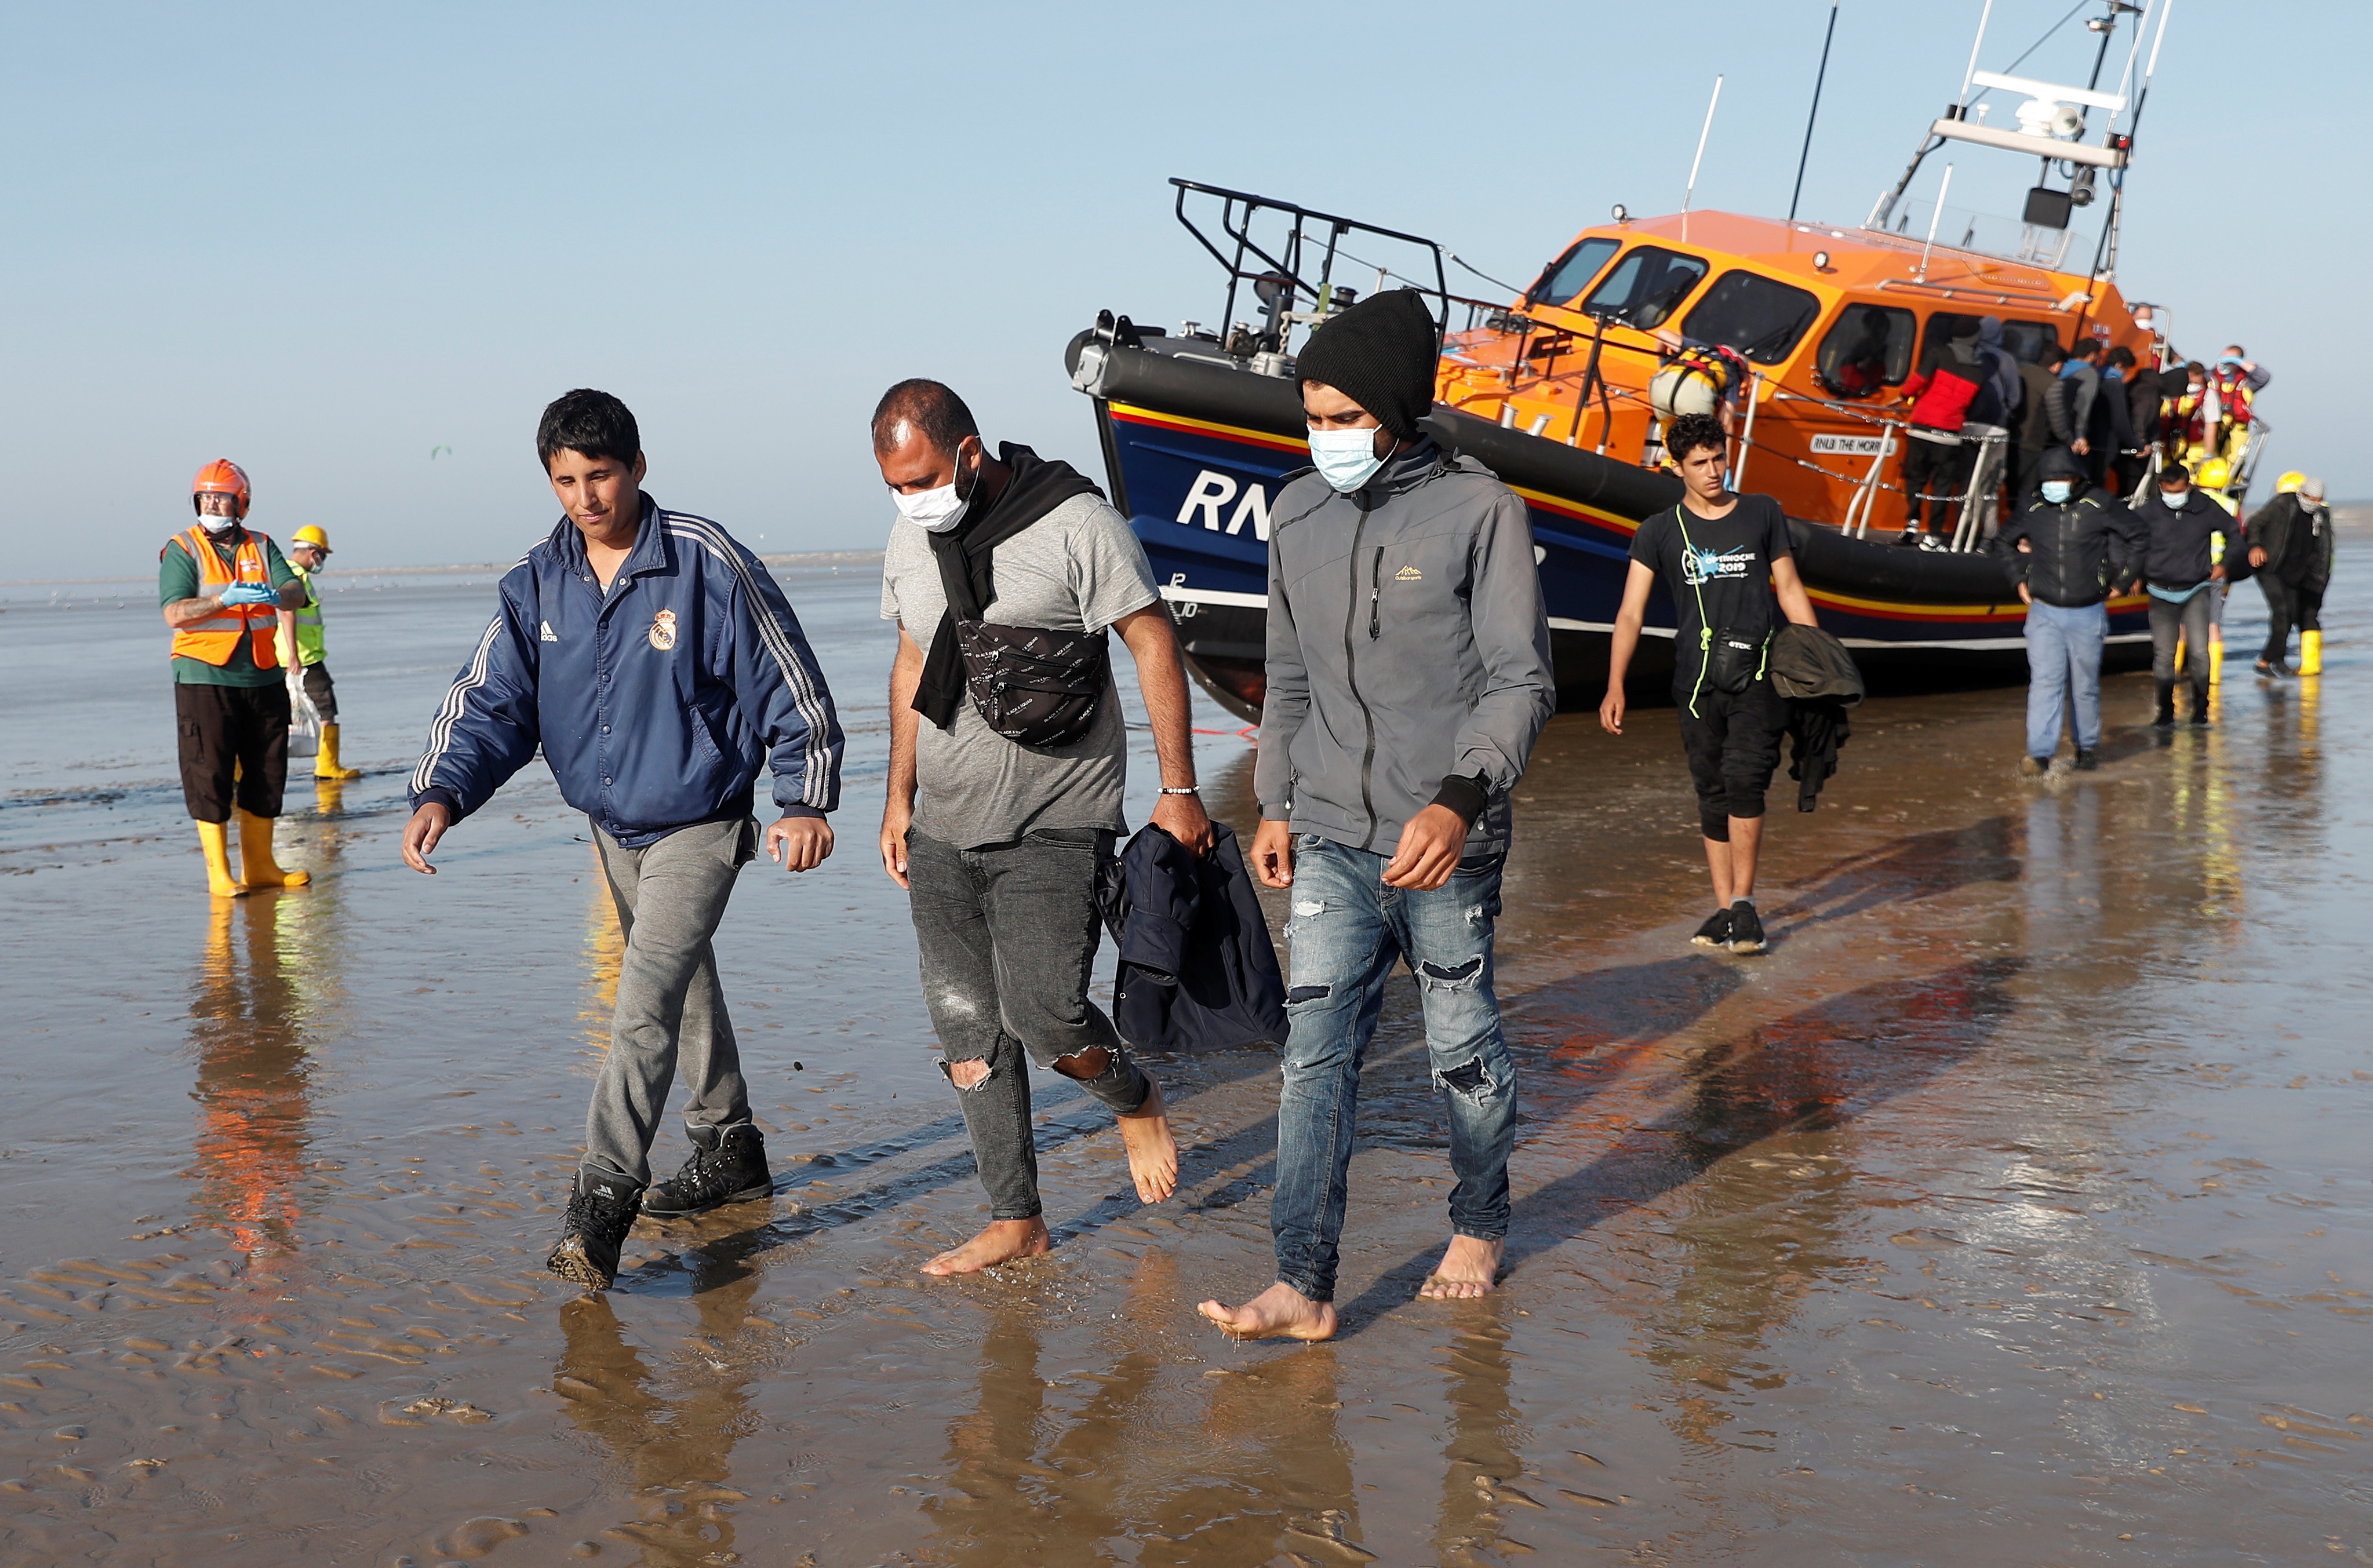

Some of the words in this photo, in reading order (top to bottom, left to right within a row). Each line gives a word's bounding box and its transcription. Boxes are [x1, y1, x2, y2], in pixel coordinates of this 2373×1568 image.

[1814, 438, 1835, 450] RNLB
[1838, 439, 1854, 451] THE
[1855, 440, 1891, 453] MORRL
[1718, 561, 1746, 572] 2019
[1170, 572, 1186, 589] 12
[1181, 601, 1198, 618] 10
[1006, 708, 1018, 716] BLACK
[1020, 698, 1033, 708] SQUAD
[592, 1188, 615, 1201] TRESPASS
